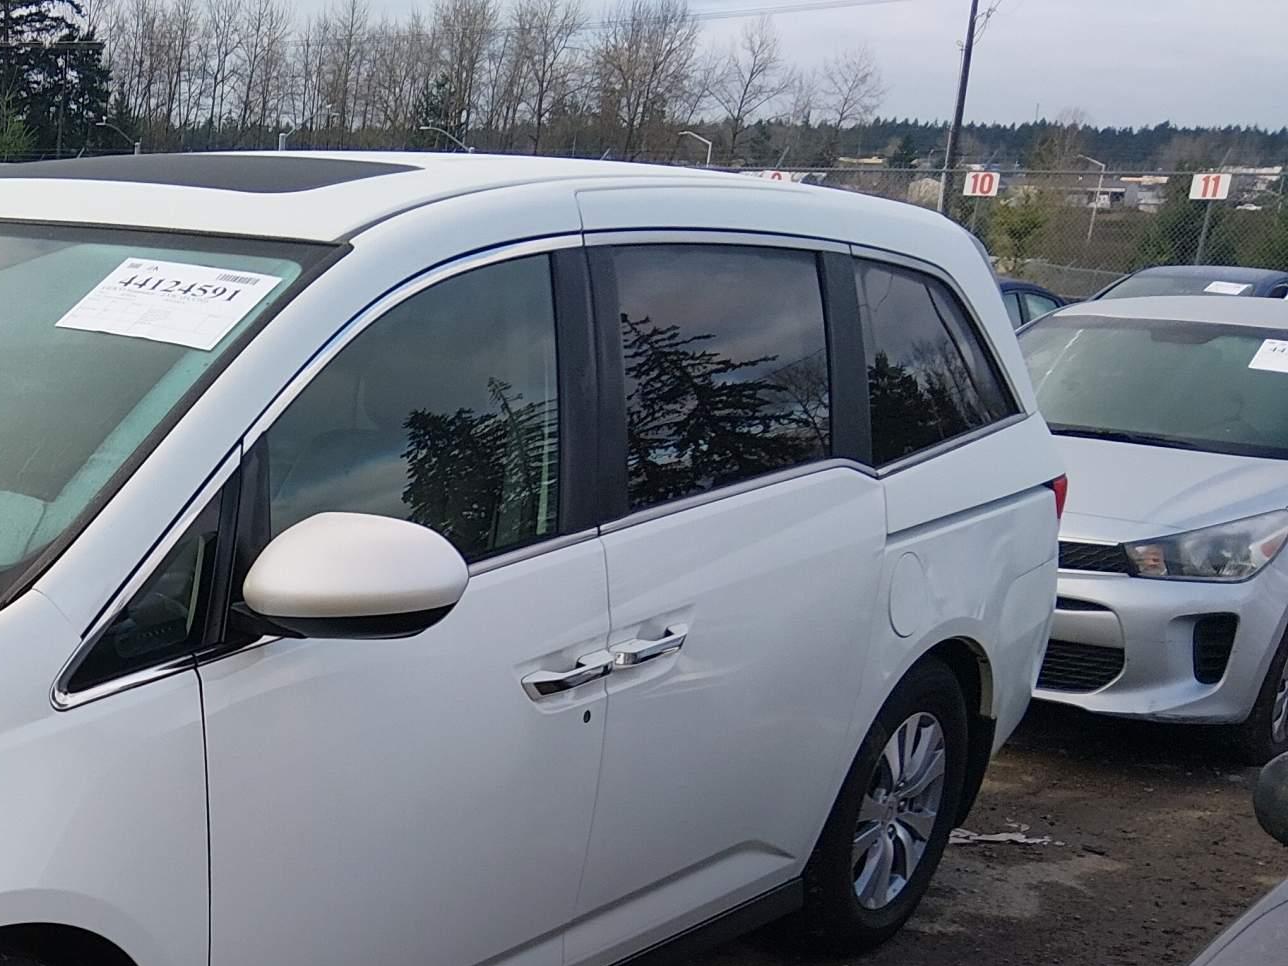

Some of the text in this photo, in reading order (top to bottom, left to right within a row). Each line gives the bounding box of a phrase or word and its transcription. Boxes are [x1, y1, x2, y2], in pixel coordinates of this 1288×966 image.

[971, 173, 994, 194] 10
[1201, 175, 1221, 198] 11
[119, 275, 242, 302] 44124591
